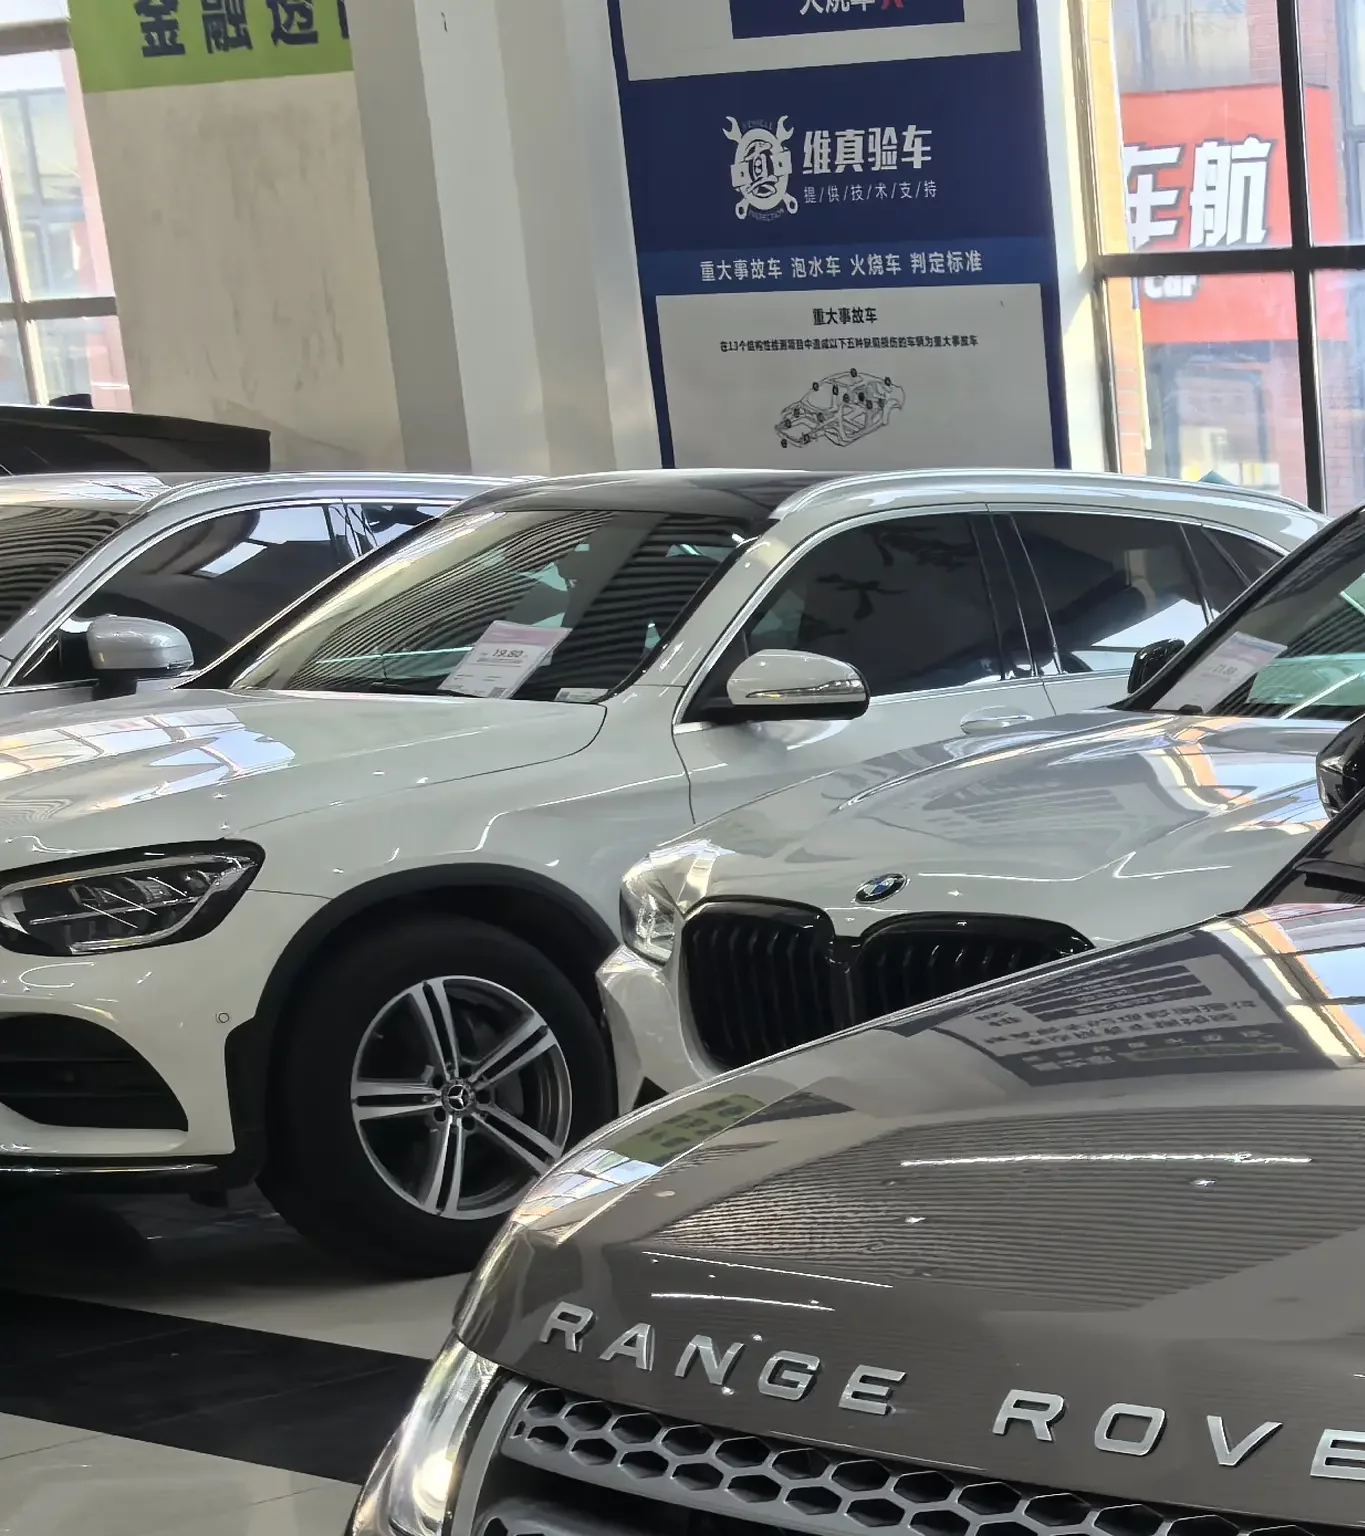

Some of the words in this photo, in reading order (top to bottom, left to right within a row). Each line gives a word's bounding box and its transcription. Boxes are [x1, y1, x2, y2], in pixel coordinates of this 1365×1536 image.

[803, 125, 932, 174] 维真验车
[700, 259, 782, 282] 重大事故车
[790, 255, 840, 278] 泡水车
[850, 253, 901, 276] 火烧车
[909, 249, 982, 274] 判定标准
[812, 307, 877, 325] 重大事故车
[539, 1301, 906, 1415] RANGE
